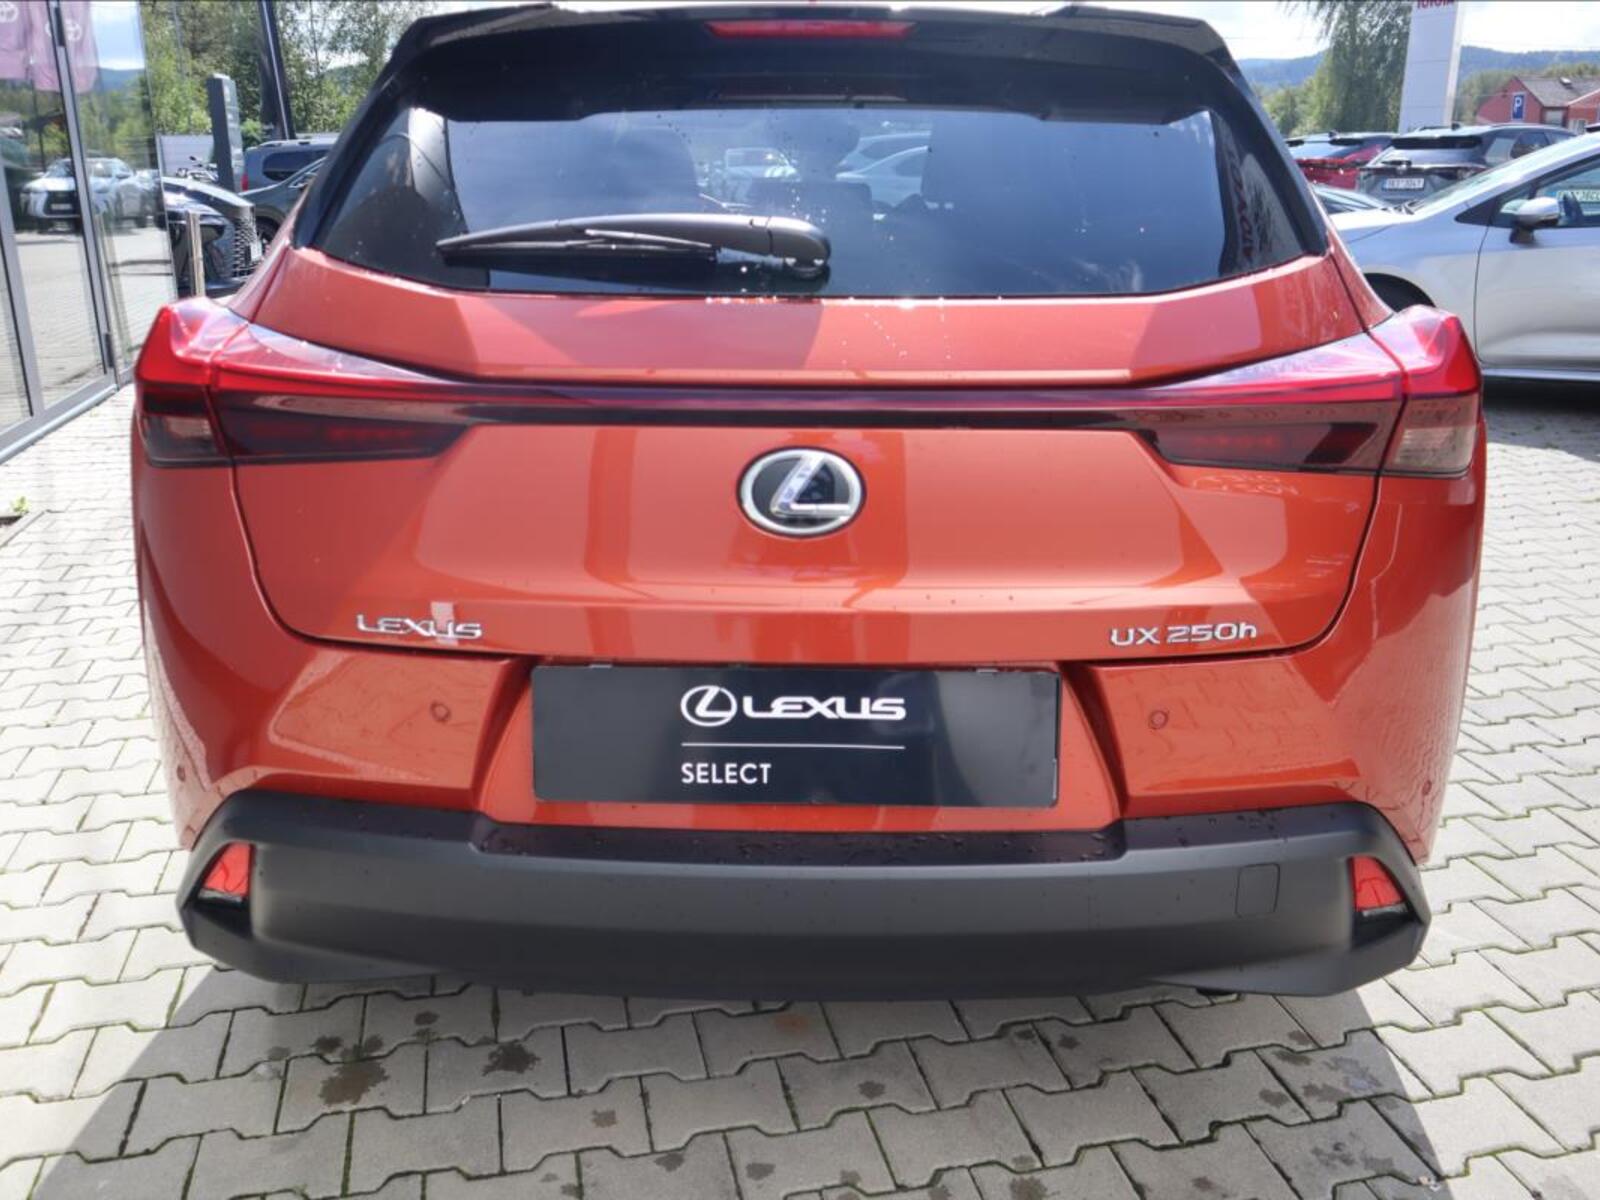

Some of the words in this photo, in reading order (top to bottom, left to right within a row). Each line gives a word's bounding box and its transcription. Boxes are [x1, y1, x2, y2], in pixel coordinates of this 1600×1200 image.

[1513, 96, 1522, 113] P
[356, 613, 482, 640] LEXUS
[1110, 627, 1161, 646] UX
[1166, 621, 1257, 643] 250h
[743, 696, 906, 720] LEXUS
[681, 762, 772, 785] SELECT
